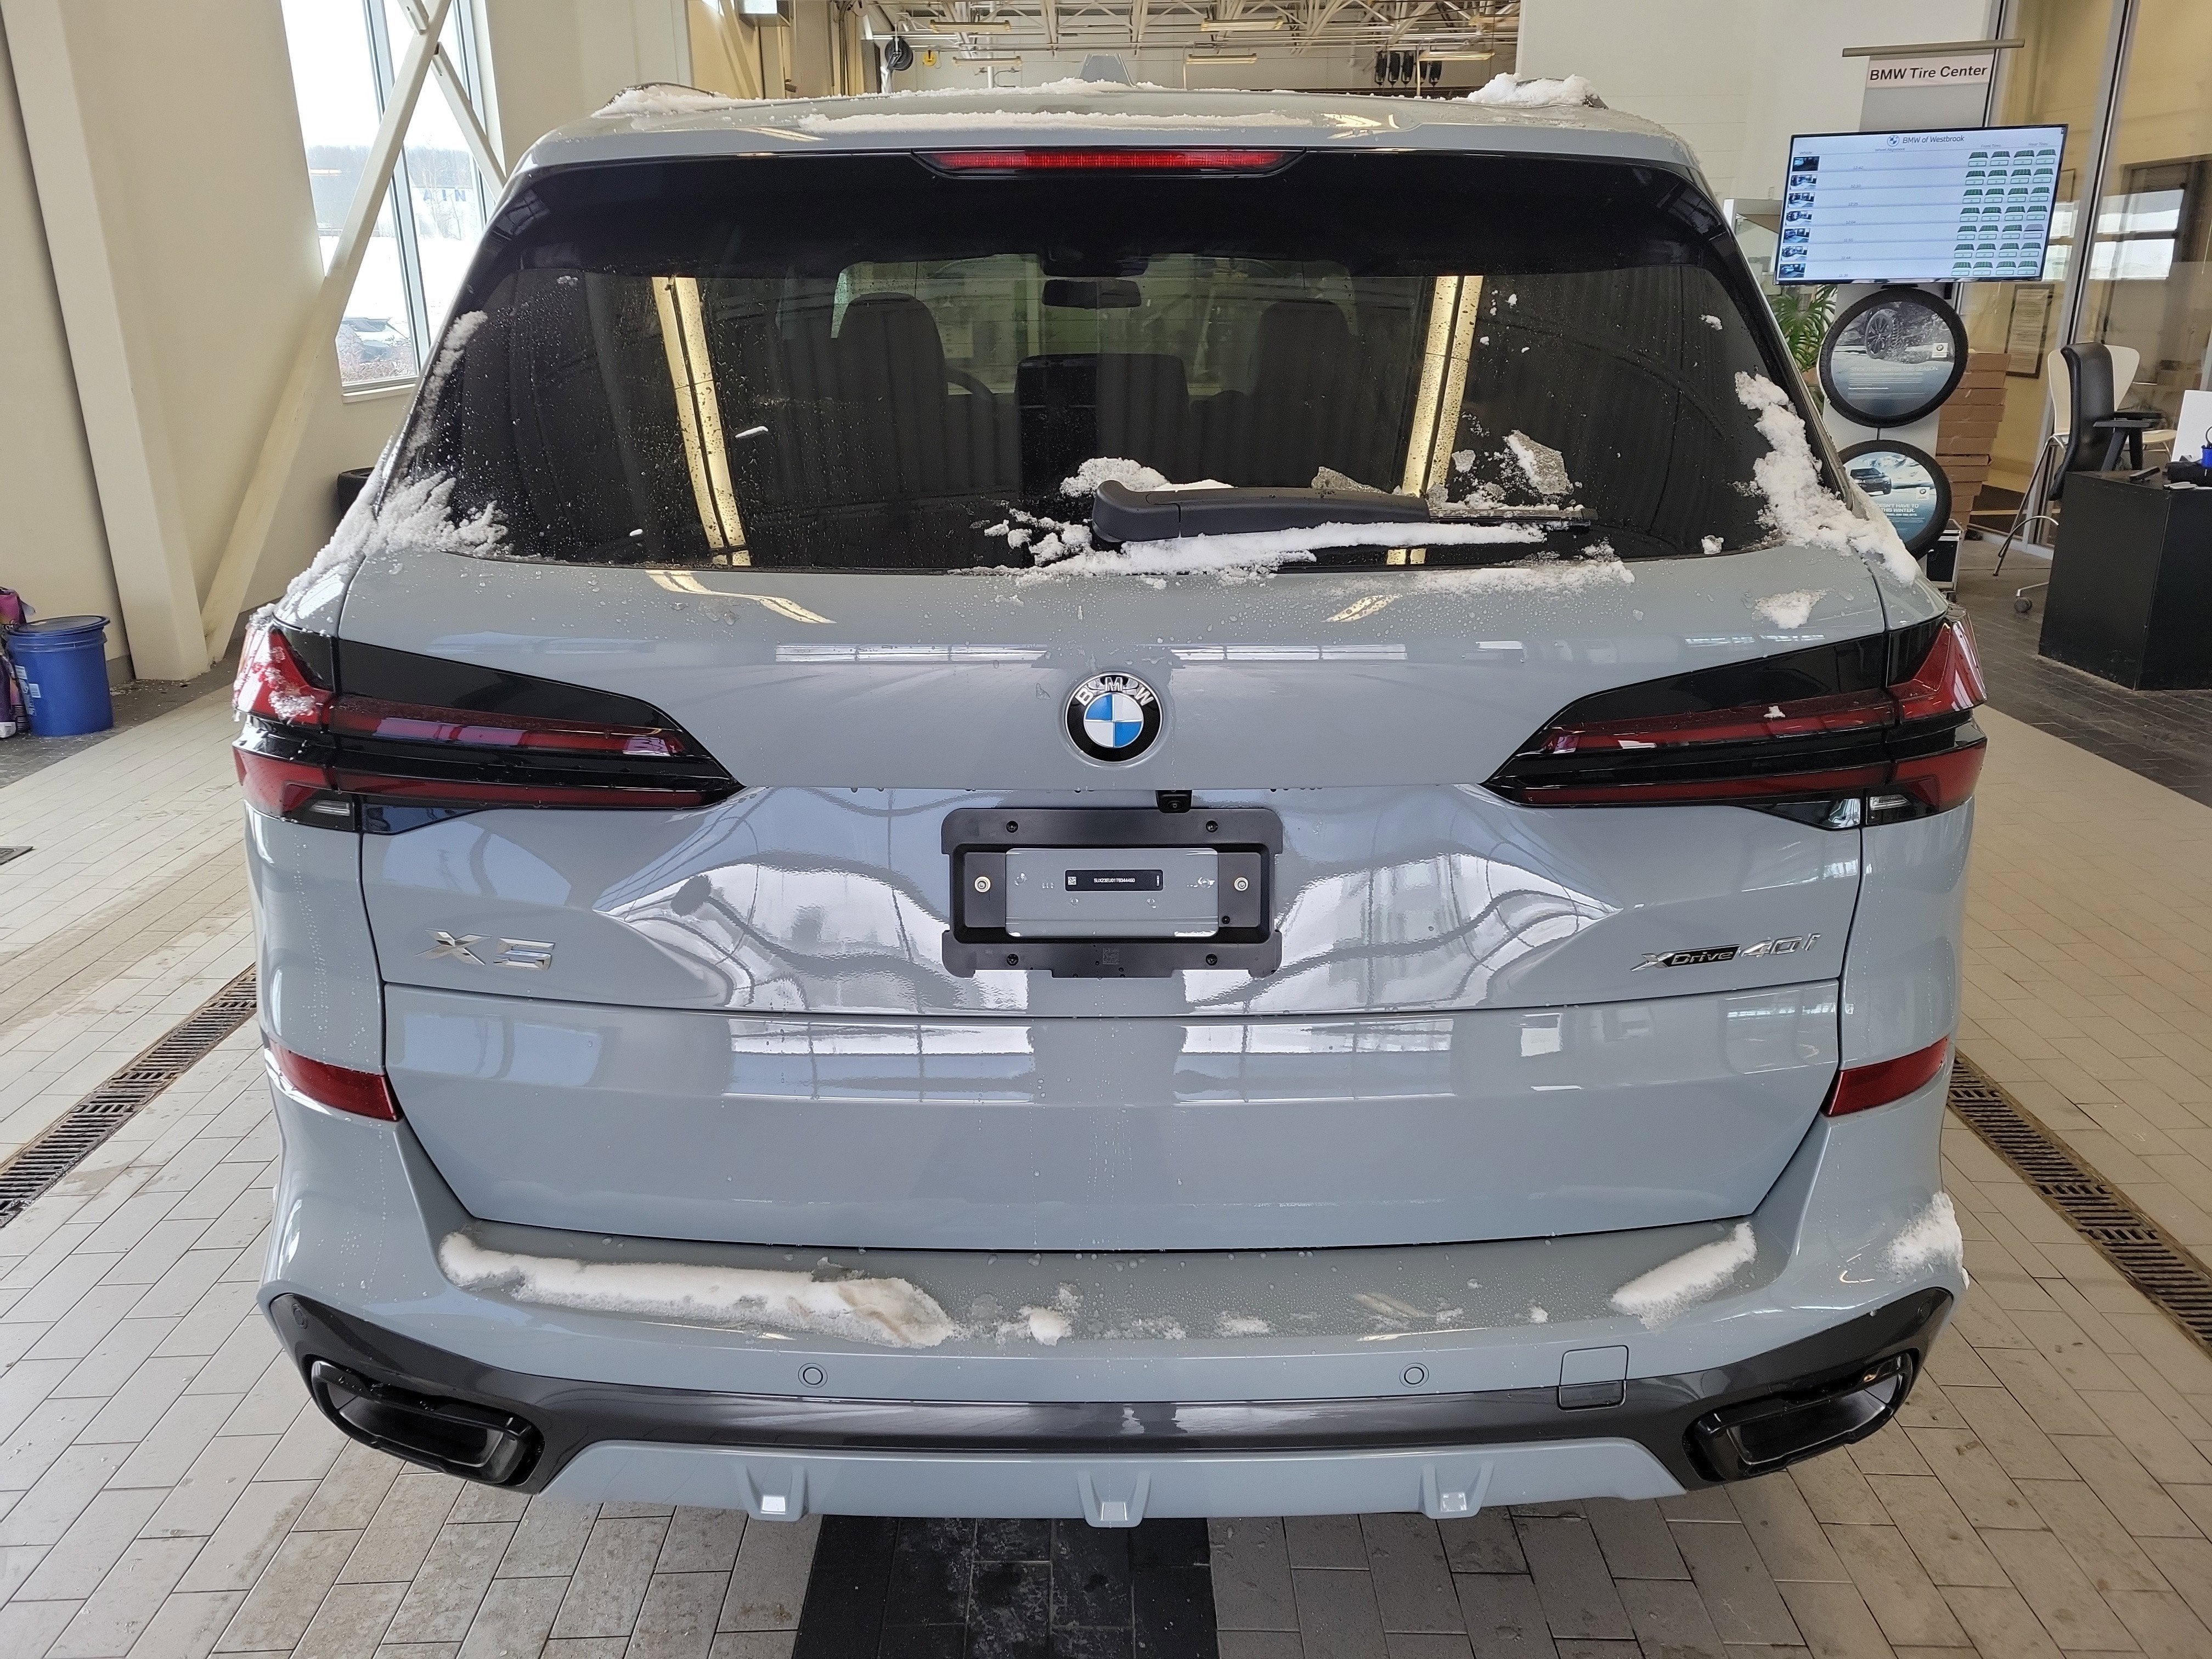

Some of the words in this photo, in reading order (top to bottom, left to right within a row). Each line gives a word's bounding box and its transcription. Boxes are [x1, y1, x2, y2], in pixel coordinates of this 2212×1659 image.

[1870, 68, 1908, 81] BMW
[1910, 67, 1937, 79] Tire
[1940, 66, 1988, 77] Center
[1075, 676, 1154, 707] BMW
[414, 927, 556, 970] X5
[1739, 933, 1821, 958] 40i
